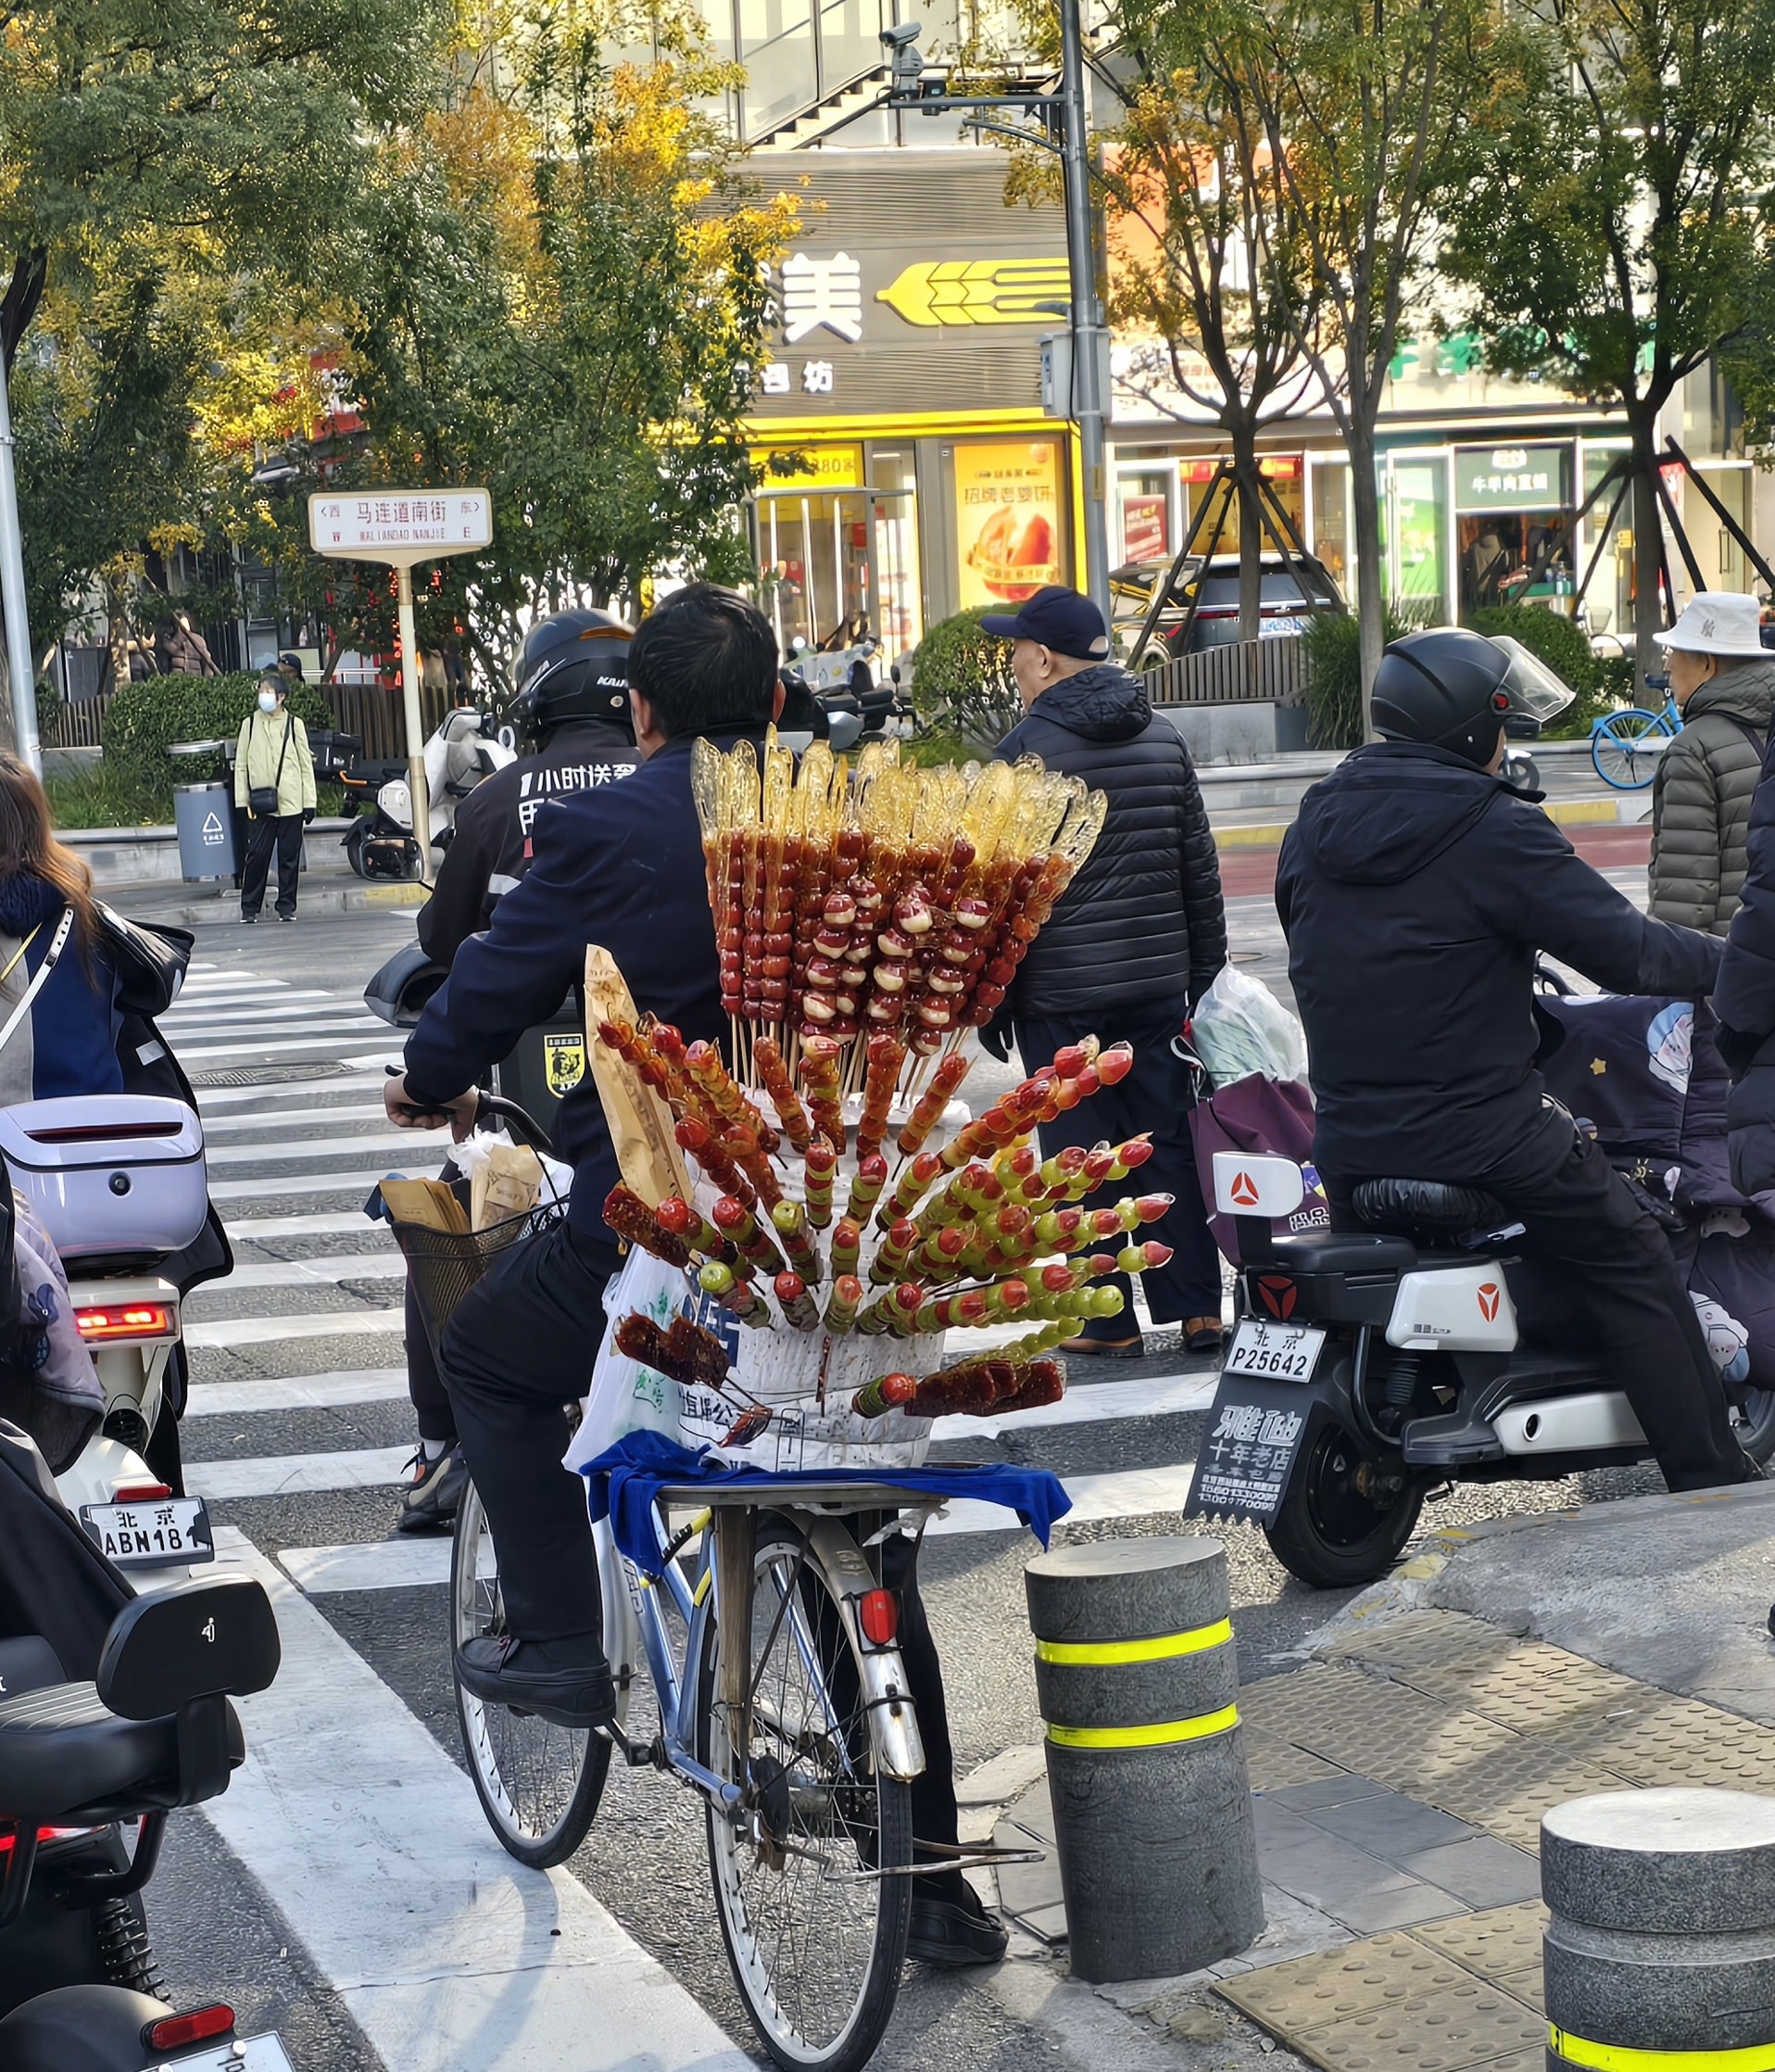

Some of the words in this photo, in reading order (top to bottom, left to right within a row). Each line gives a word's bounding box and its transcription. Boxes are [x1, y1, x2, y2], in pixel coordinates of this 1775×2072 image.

[759, 251, 863, 345] 美
[357, 501, 446, 524] 马连道南街
[1254, 1333, 1299, 1350] 北京
[1232, 1347, 1307, 1376] P25642
[1212, 1405, 1303, 1447] 雅迪
[1209, 1439, 1291, 1471] 十年老店
[118, 1506, 175, 1528] 北京
